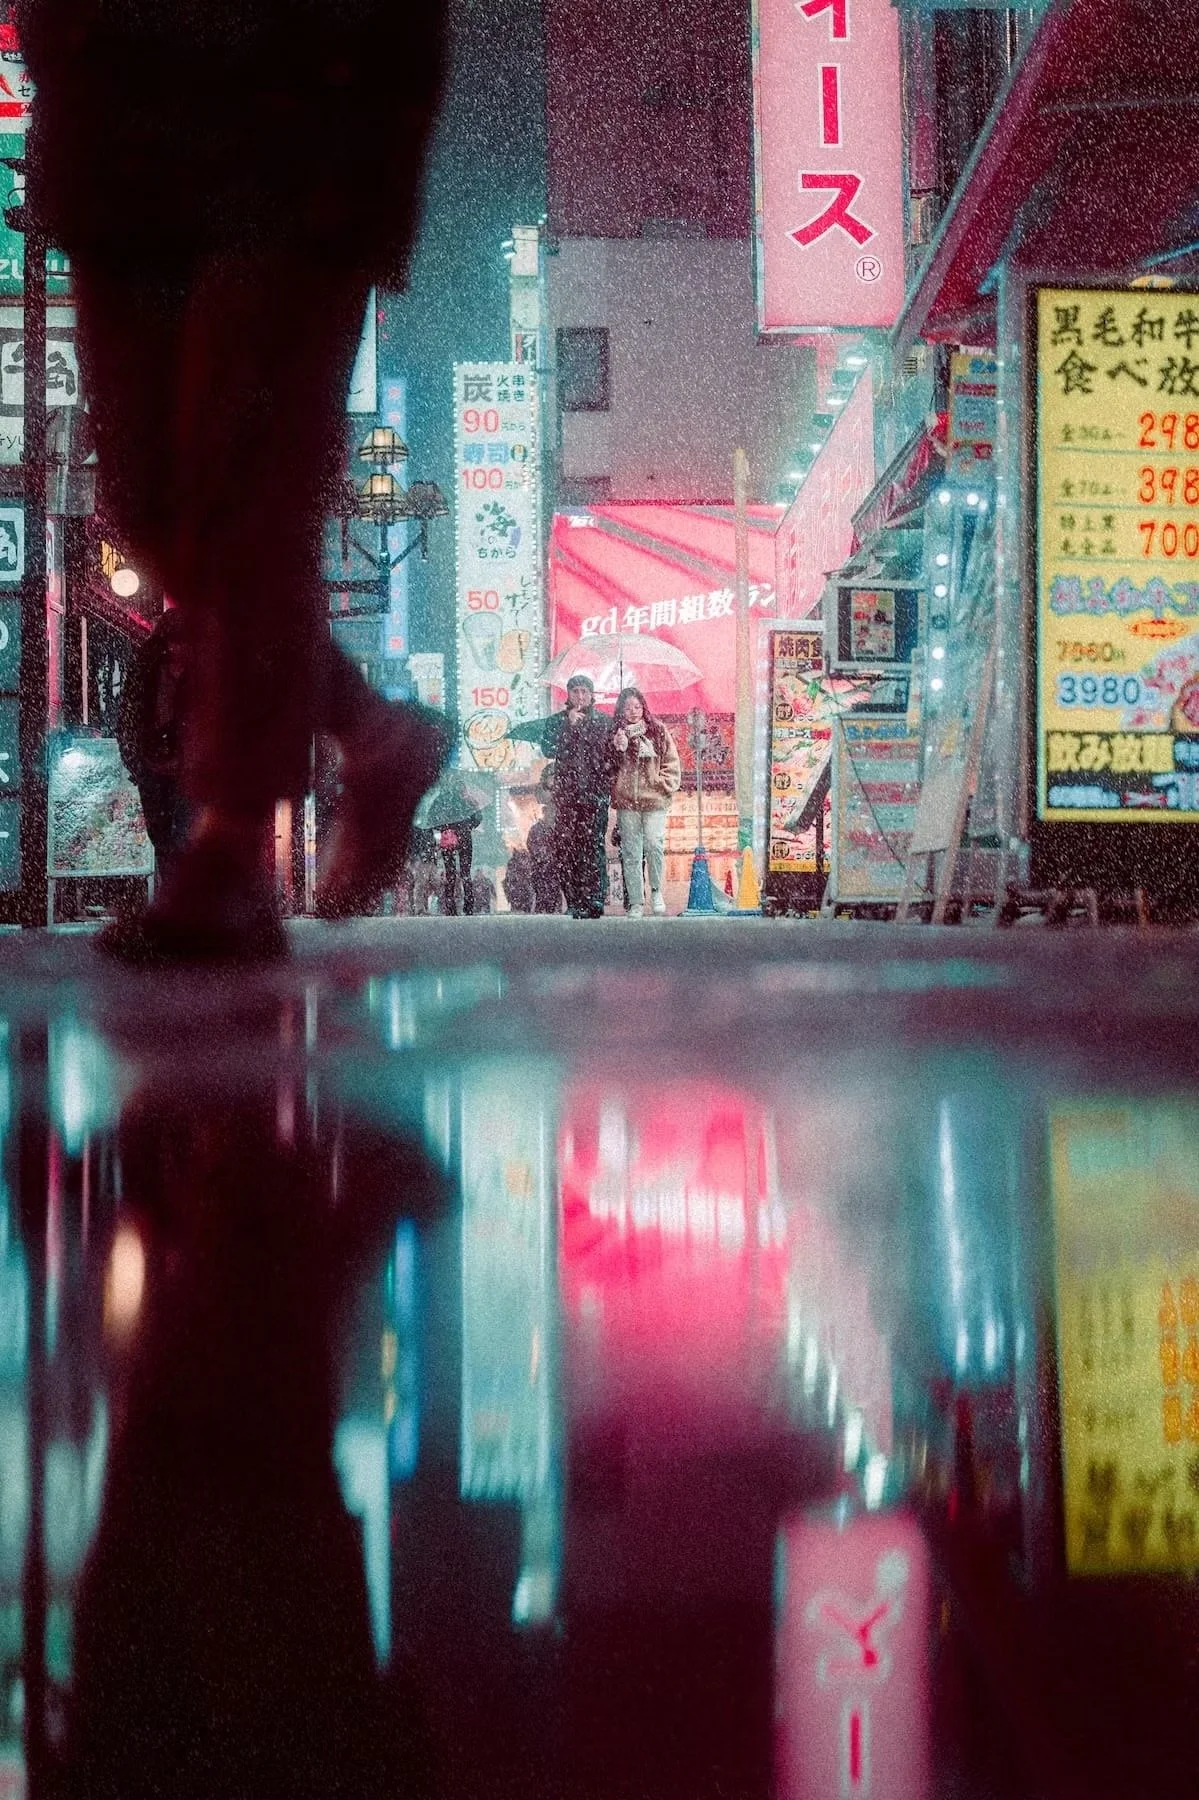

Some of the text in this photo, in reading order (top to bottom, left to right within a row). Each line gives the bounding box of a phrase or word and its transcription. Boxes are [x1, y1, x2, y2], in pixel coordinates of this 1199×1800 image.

[1051, 304, 1199, 350] 黒毛和牛
[1053, 350, 1199, 396] 食べ放
[463, 408, 499, 433] 90
[1138, 411, 1199, 450] 298
[462, 467, 503, 490] 100
[1138, 467, 1199, 505] 398
[477, 546, 517, 559] ちから
[1138, 521, 1199, 558] 700
[467, 590, 499, 612] 50
[472, 687, 510, 707] 150
[1060, 676, 1140, 704] 3980
